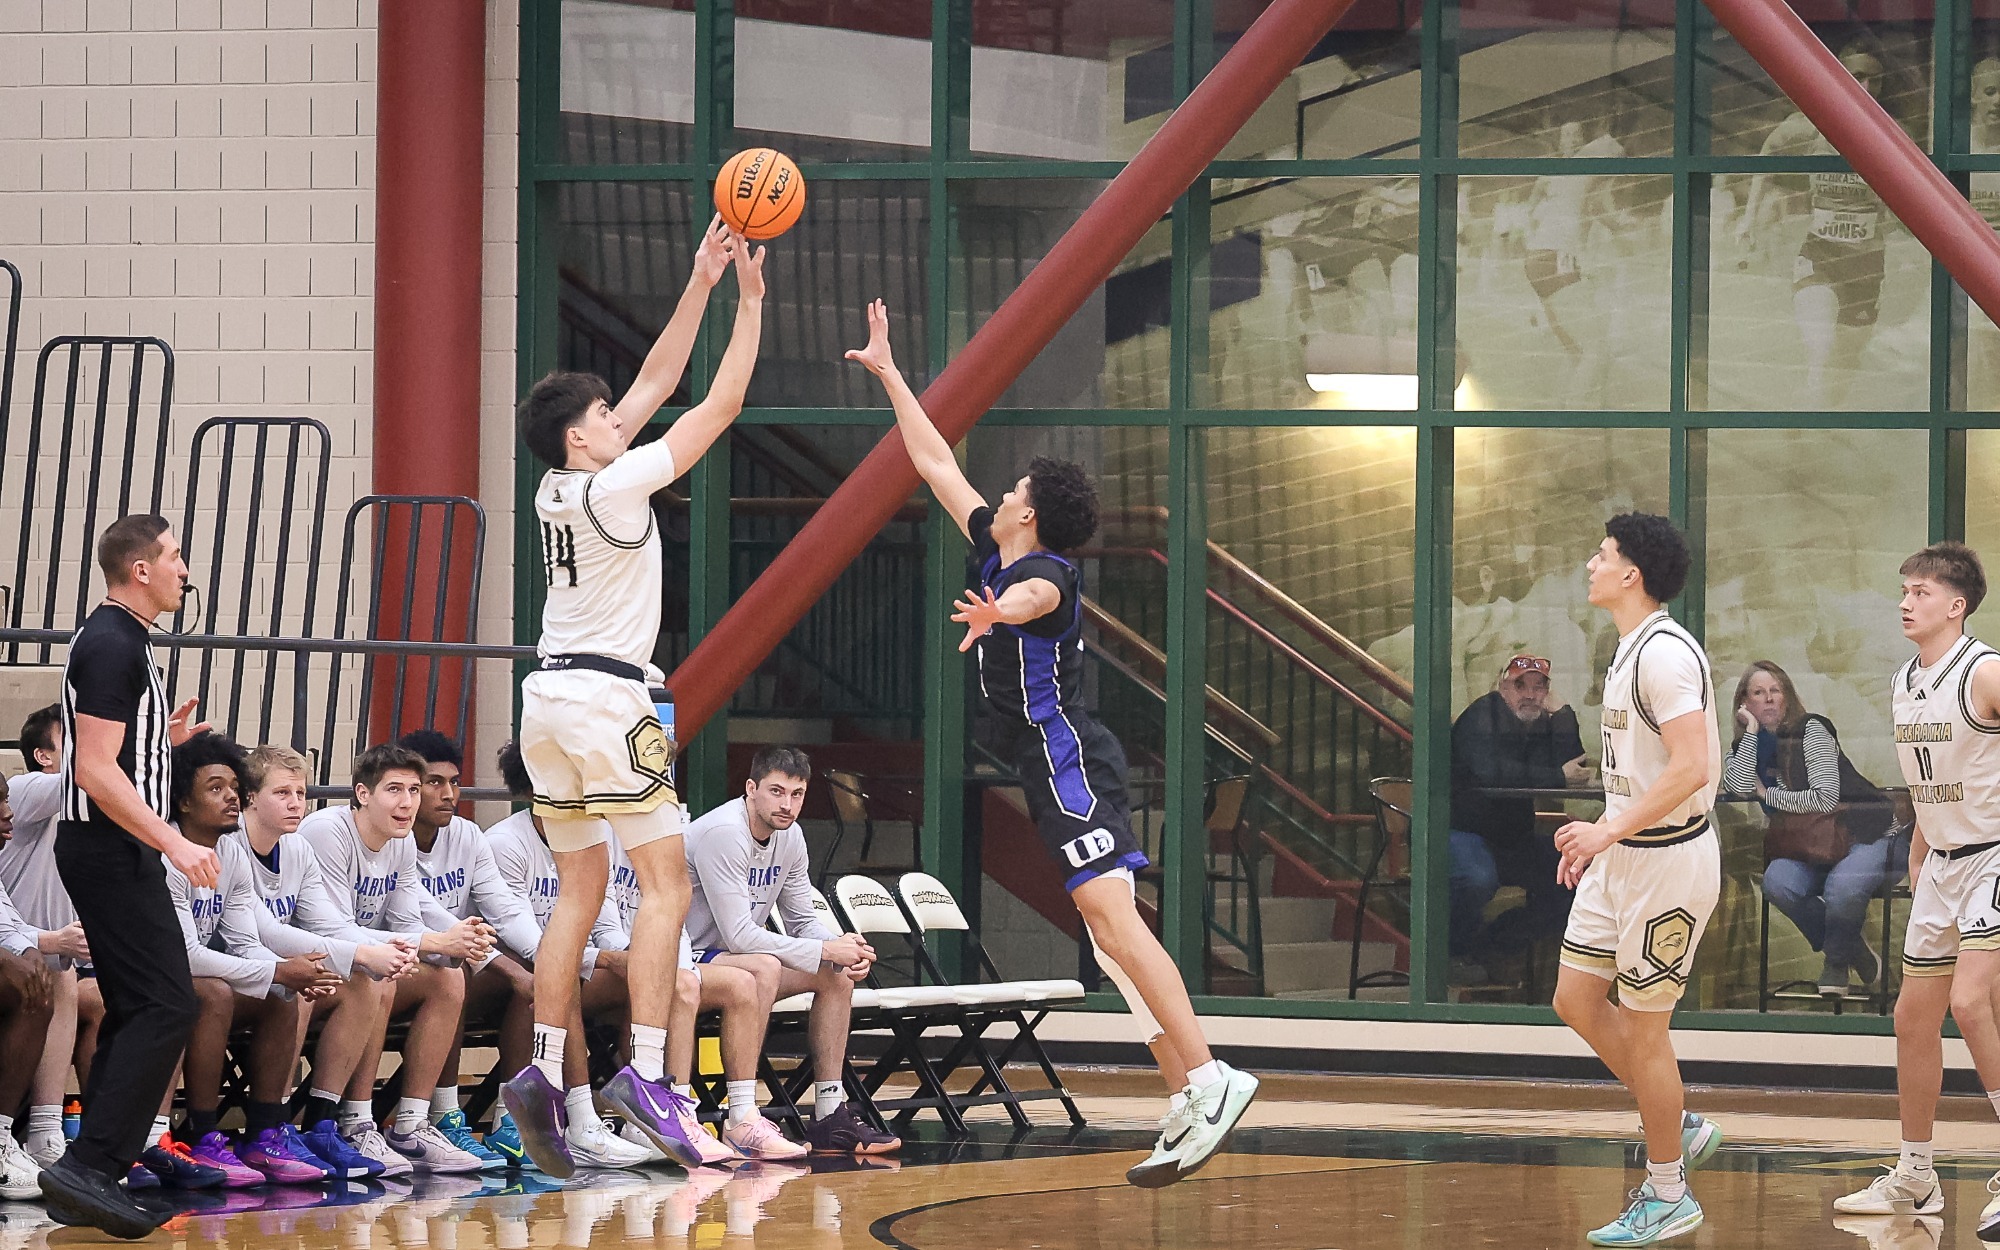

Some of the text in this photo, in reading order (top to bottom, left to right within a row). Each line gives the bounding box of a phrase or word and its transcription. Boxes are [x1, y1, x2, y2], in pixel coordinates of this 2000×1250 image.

[737, 151, 769, 199] Wilson
[767, 167, 791, 206] NCAA
[1818, 221, 1867, 239] JONES
[542, 521, 578, 587] 14
[1913, 746, 1933, 781] 10
